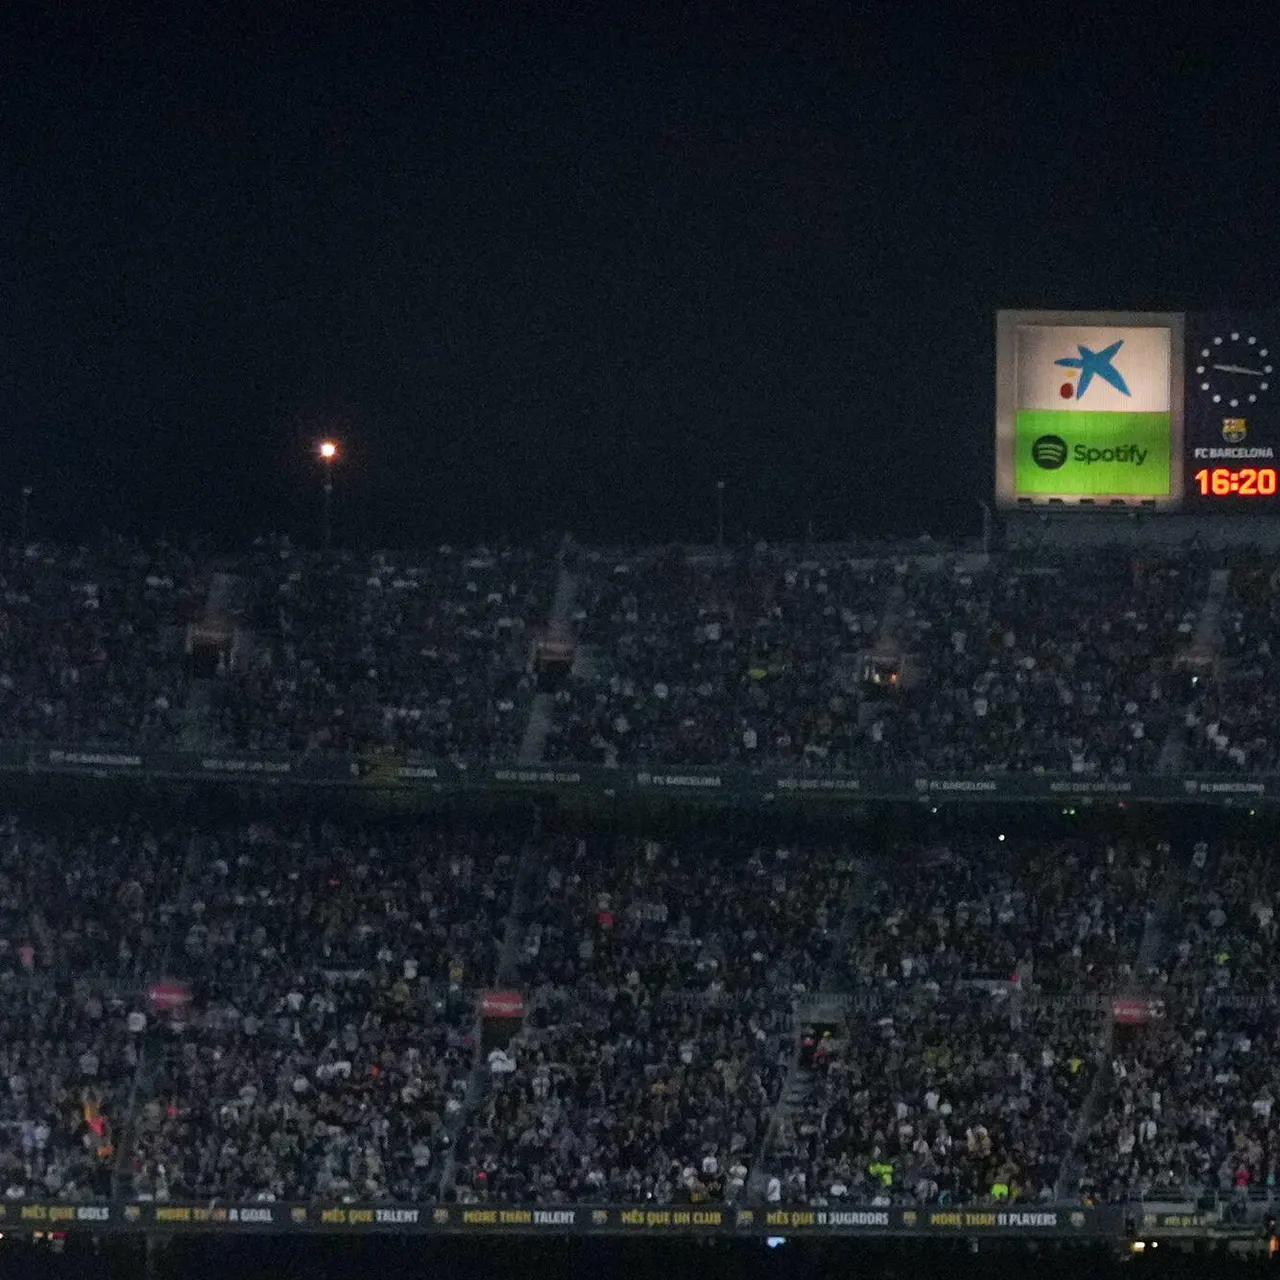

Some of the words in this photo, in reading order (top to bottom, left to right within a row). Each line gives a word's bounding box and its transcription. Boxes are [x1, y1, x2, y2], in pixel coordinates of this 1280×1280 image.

[1073, 444, 1148, 466] Spotify
[1195, 447, 1209, 459] FC
[1210, 447, 1274, 459] BARCELONA
[1195, 467, 1278, 496] 16:20
[229, 1208, 239, 1221] A
[240, 1208, 273, 1222] GOAL
[375, 1208, 420, 1222] TALENT
[463, 1210, 498, 1224] MORE
[499, 1210, 531, 1224] THAN
[533, 1211, 576, 1224] TALENT
[621, 1209, 645, 1225] MÉS
[647, 1211, 670, 1227] QUE
[673, 1212, 690, 1225] UN
[692, 1211, 722, 1225] CLUB
[766, 1210, 789, 1225] MÉS
[791, 1212, 814, 1228] QUE
[828, 1212, 889, 1226] JUGADORS
[931, 1212, 961, 1226] MORE
[965, 1213, 995, 1226] THAN
[1009, 1212, 1057, 1226] PLAYERS
